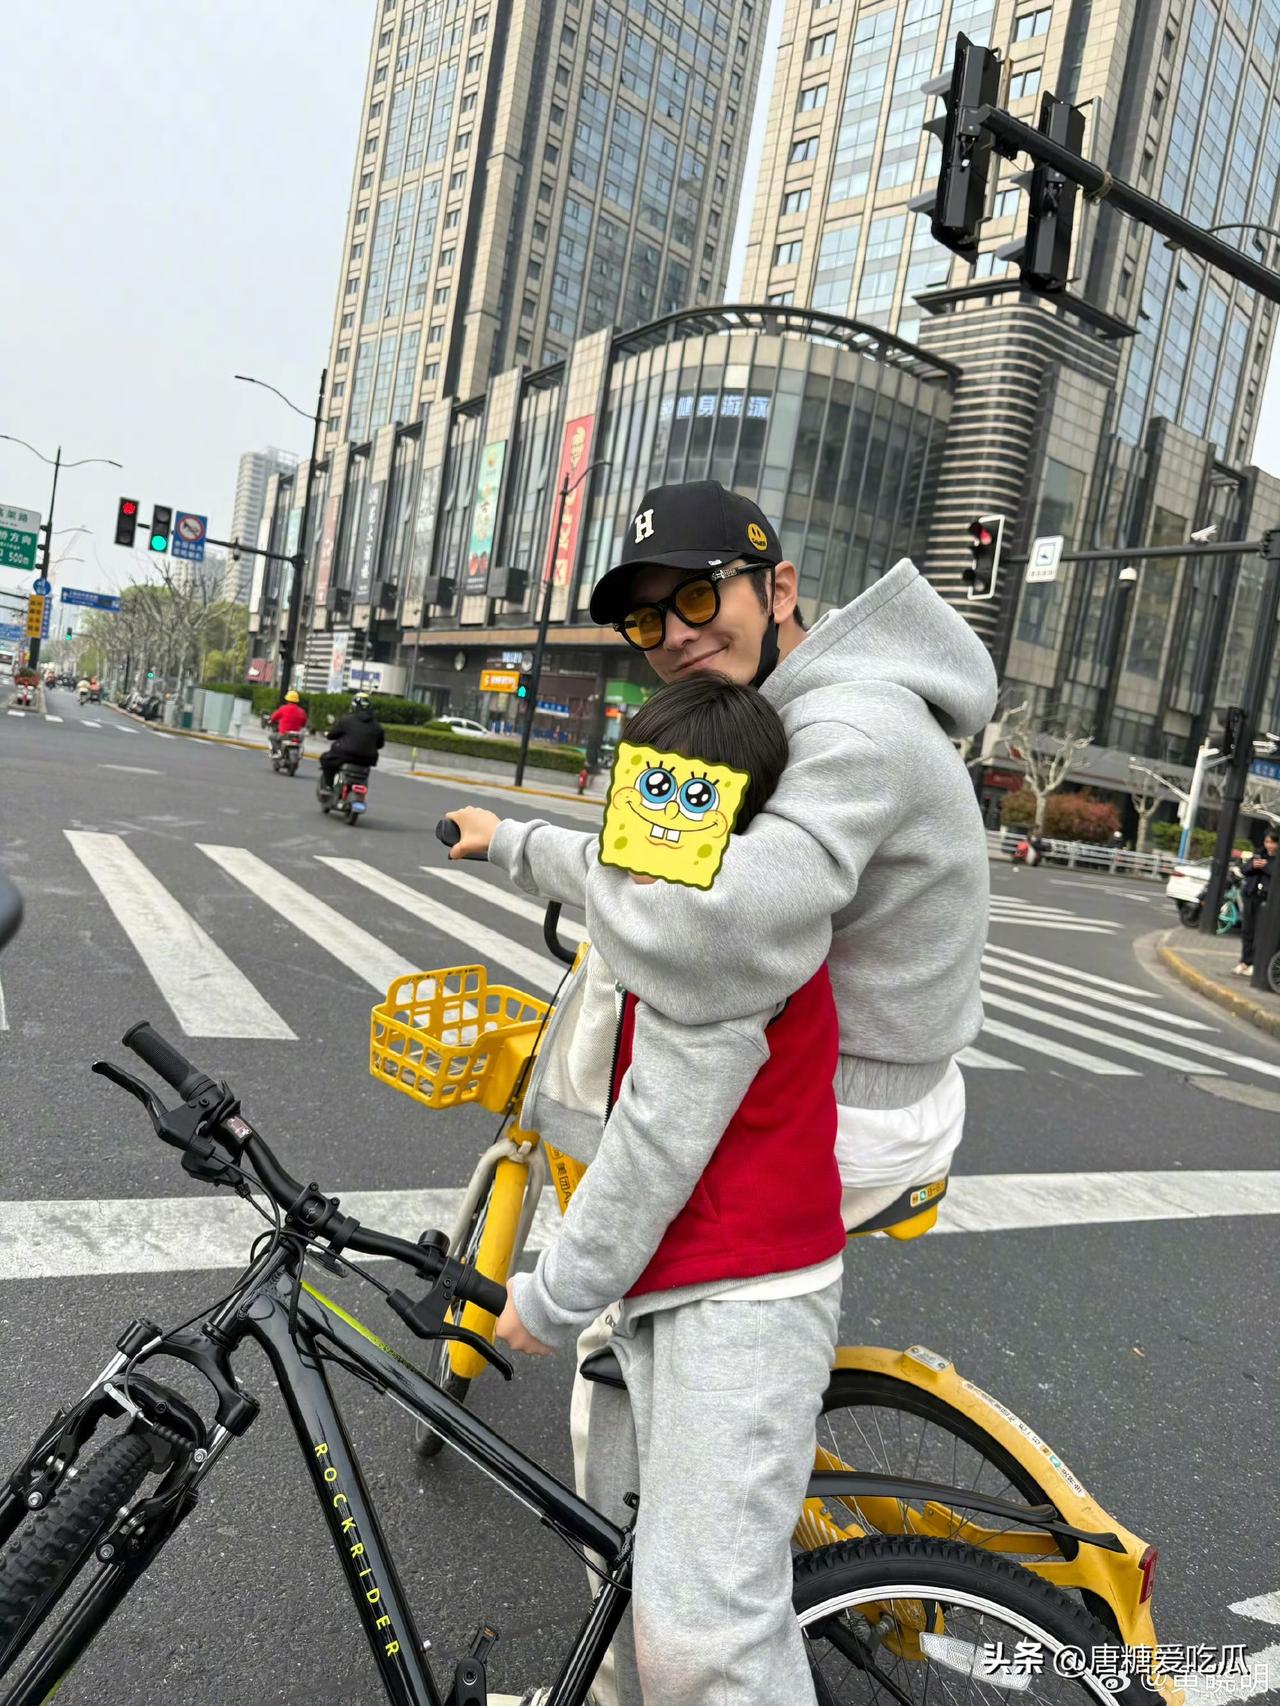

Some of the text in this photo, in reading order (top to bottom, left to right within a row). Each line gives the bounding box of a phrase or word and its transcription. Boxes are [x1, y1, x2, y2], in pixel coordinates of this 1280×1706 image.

[635, 509, 654, 543] H
[557, 1162, 572, 1207] 美团A
[315, 1443, 400, 1656] ROCKRIDER
